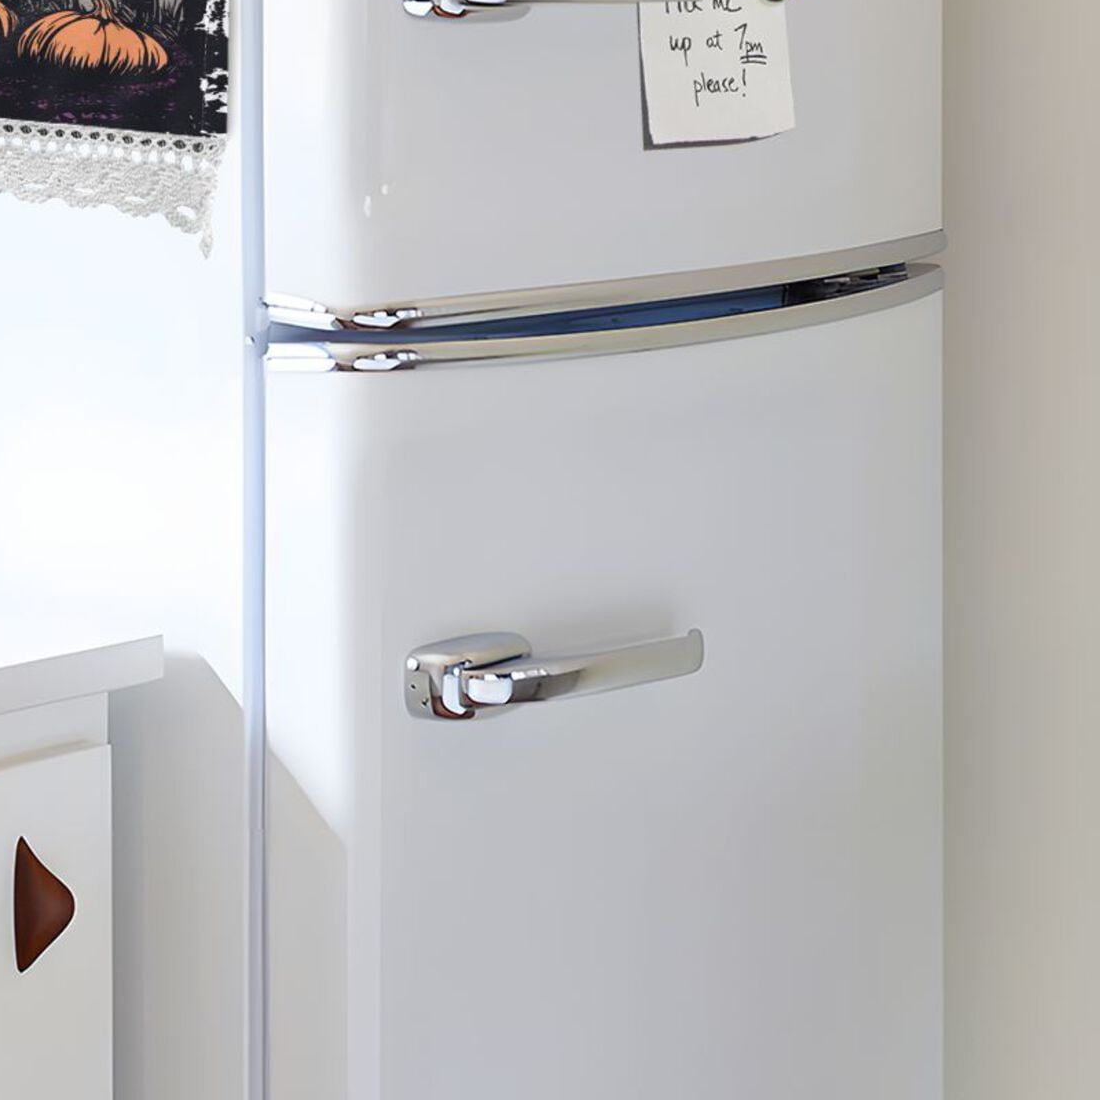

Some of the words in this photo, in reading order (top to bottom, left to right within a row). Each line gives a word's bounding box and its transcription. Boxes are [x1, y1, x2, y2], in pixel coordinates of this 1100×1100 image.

[669, 35, 692, 67] up
[706, 29, 723, 51] at
[734, 22, 765, 63] 7pm
[693, 68, 746, 107] please!
